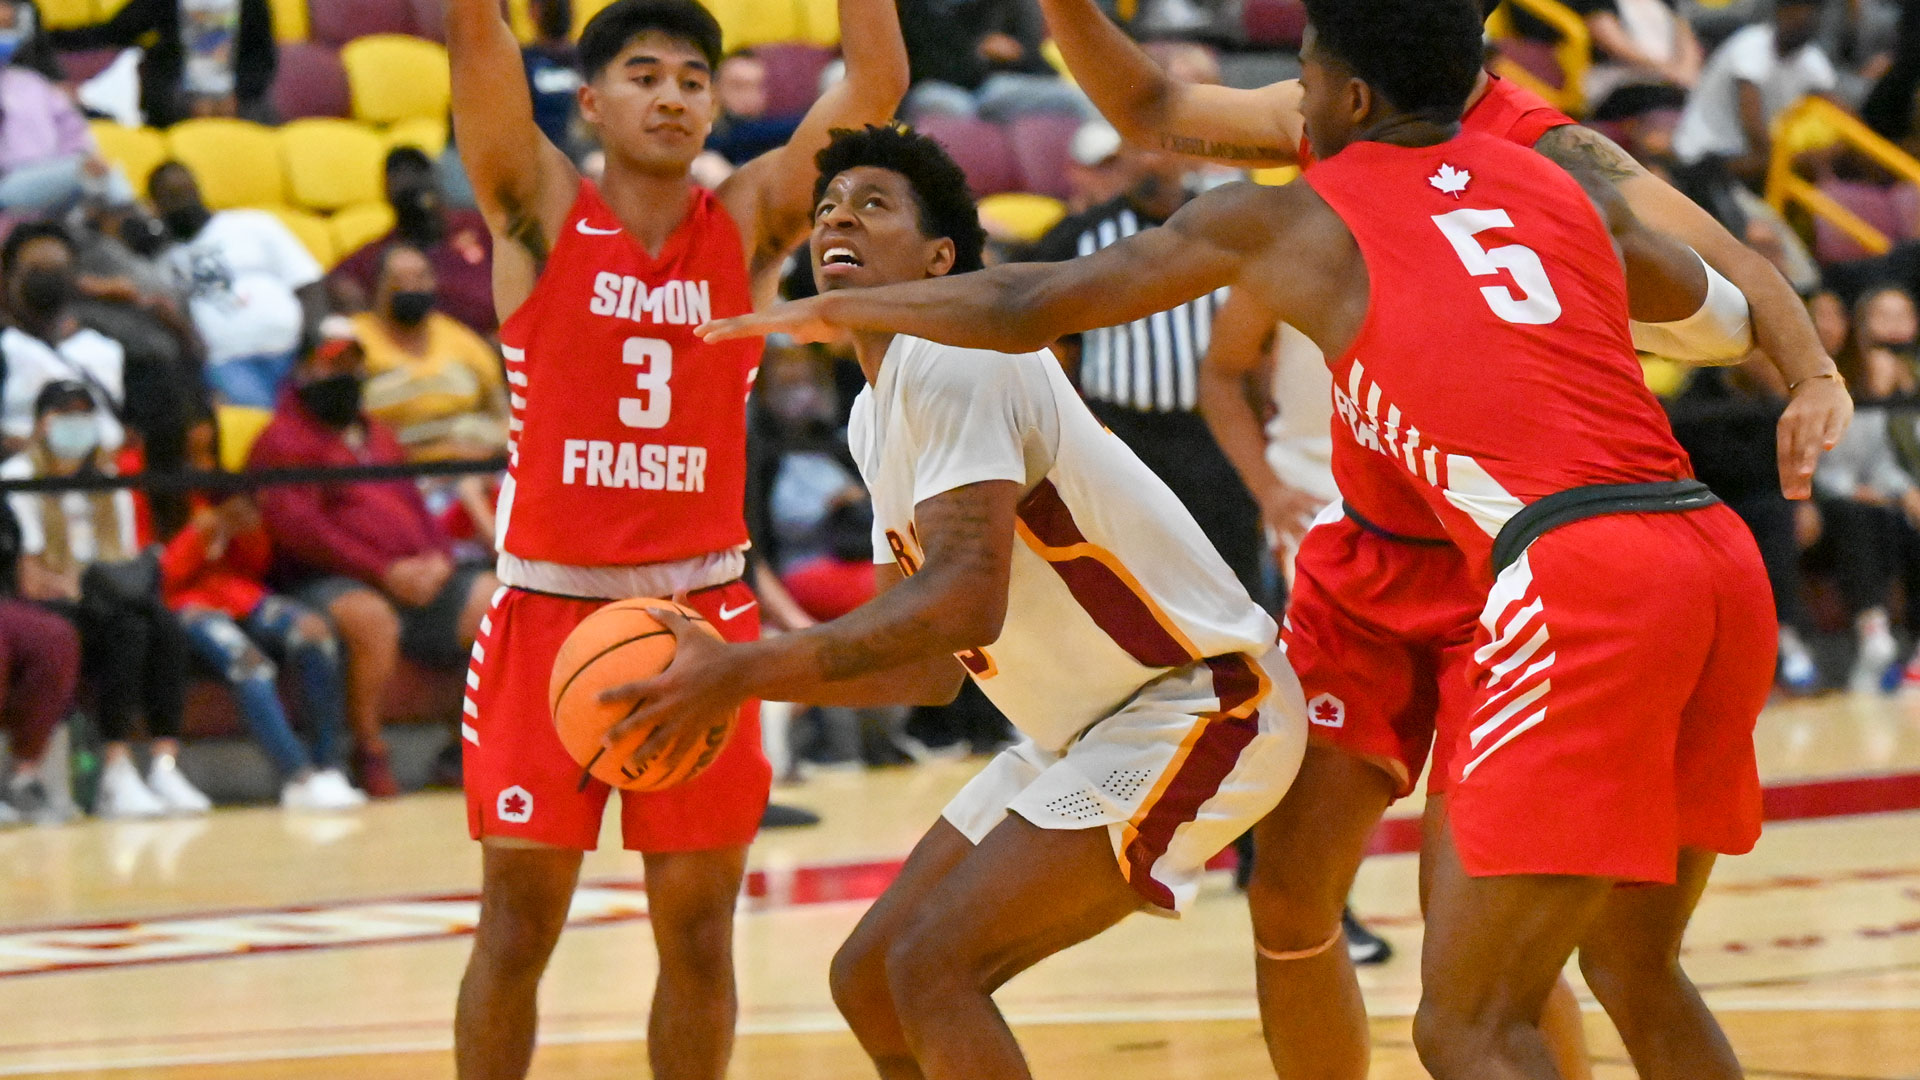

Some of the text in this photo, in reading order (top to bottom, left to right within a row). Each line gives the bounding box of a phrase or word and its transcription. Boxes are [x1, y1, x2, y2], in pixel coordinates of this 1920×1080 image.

[590, 271, 712, 325] SIMON
[1430, 208, 1562, 325] 5
[618, 336, 673, 430] 3
[562, 439, 708, 493] FRASER
